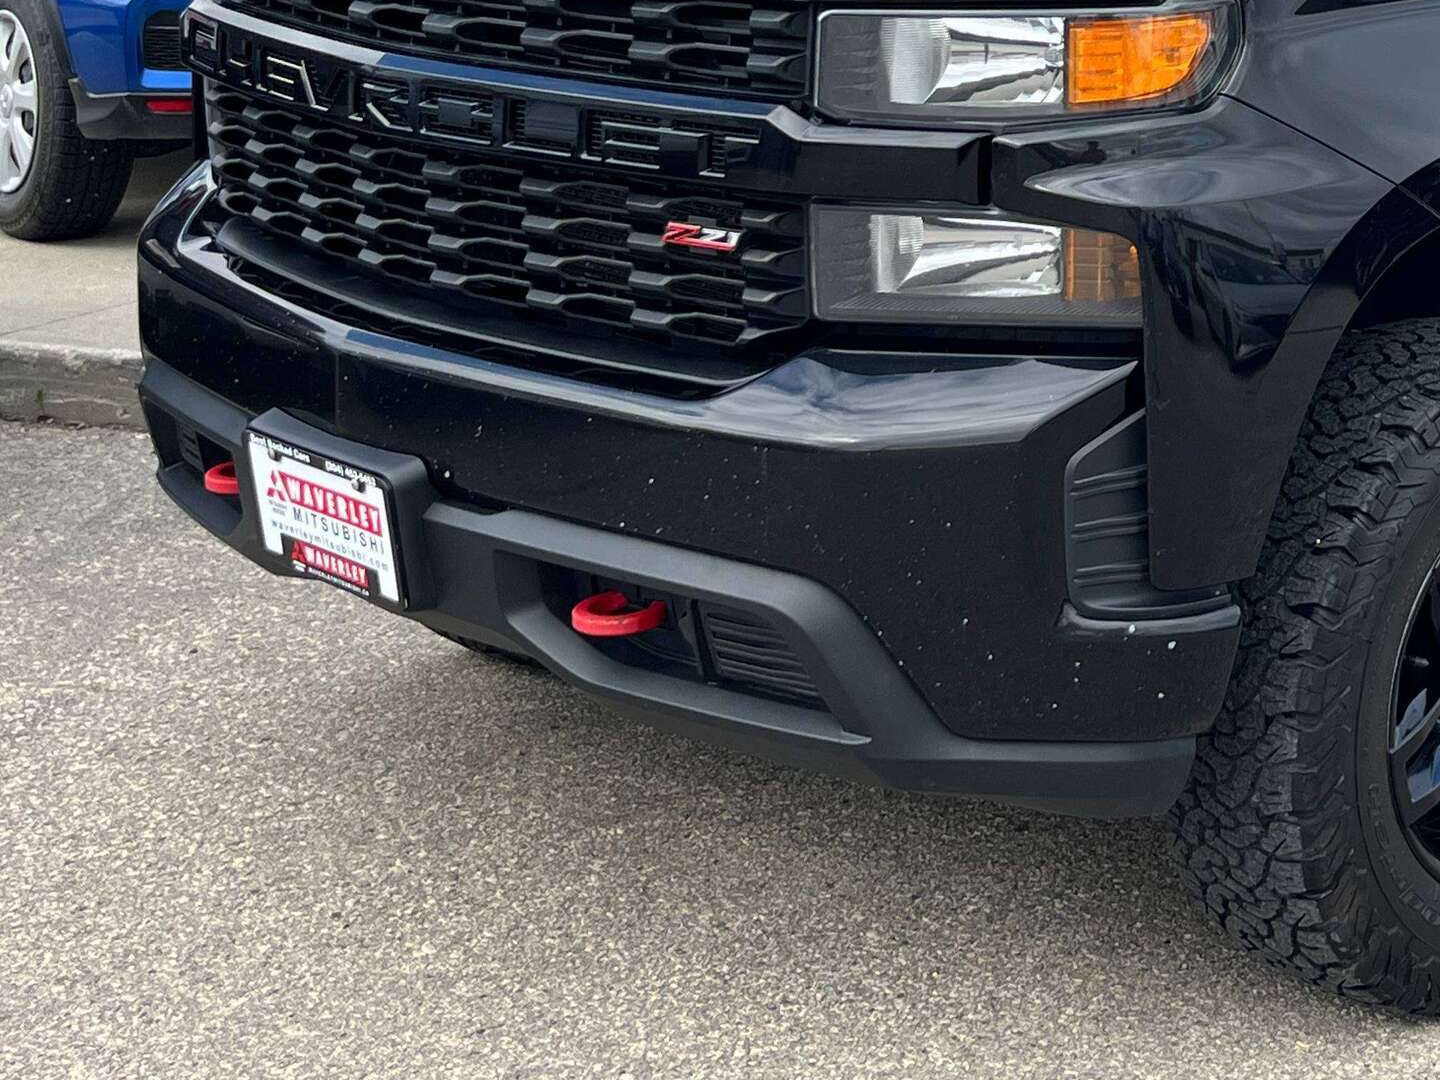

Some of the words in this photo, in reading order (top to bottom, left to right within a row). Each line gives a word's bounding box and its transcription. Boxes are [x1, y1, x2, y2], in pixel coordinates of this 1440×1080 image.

[285, 476, 380, 533] WAVERLEY
[293, 507, 385, 555] MITSUBISHI
[303, 544, 367, 582] WAVERLEY
